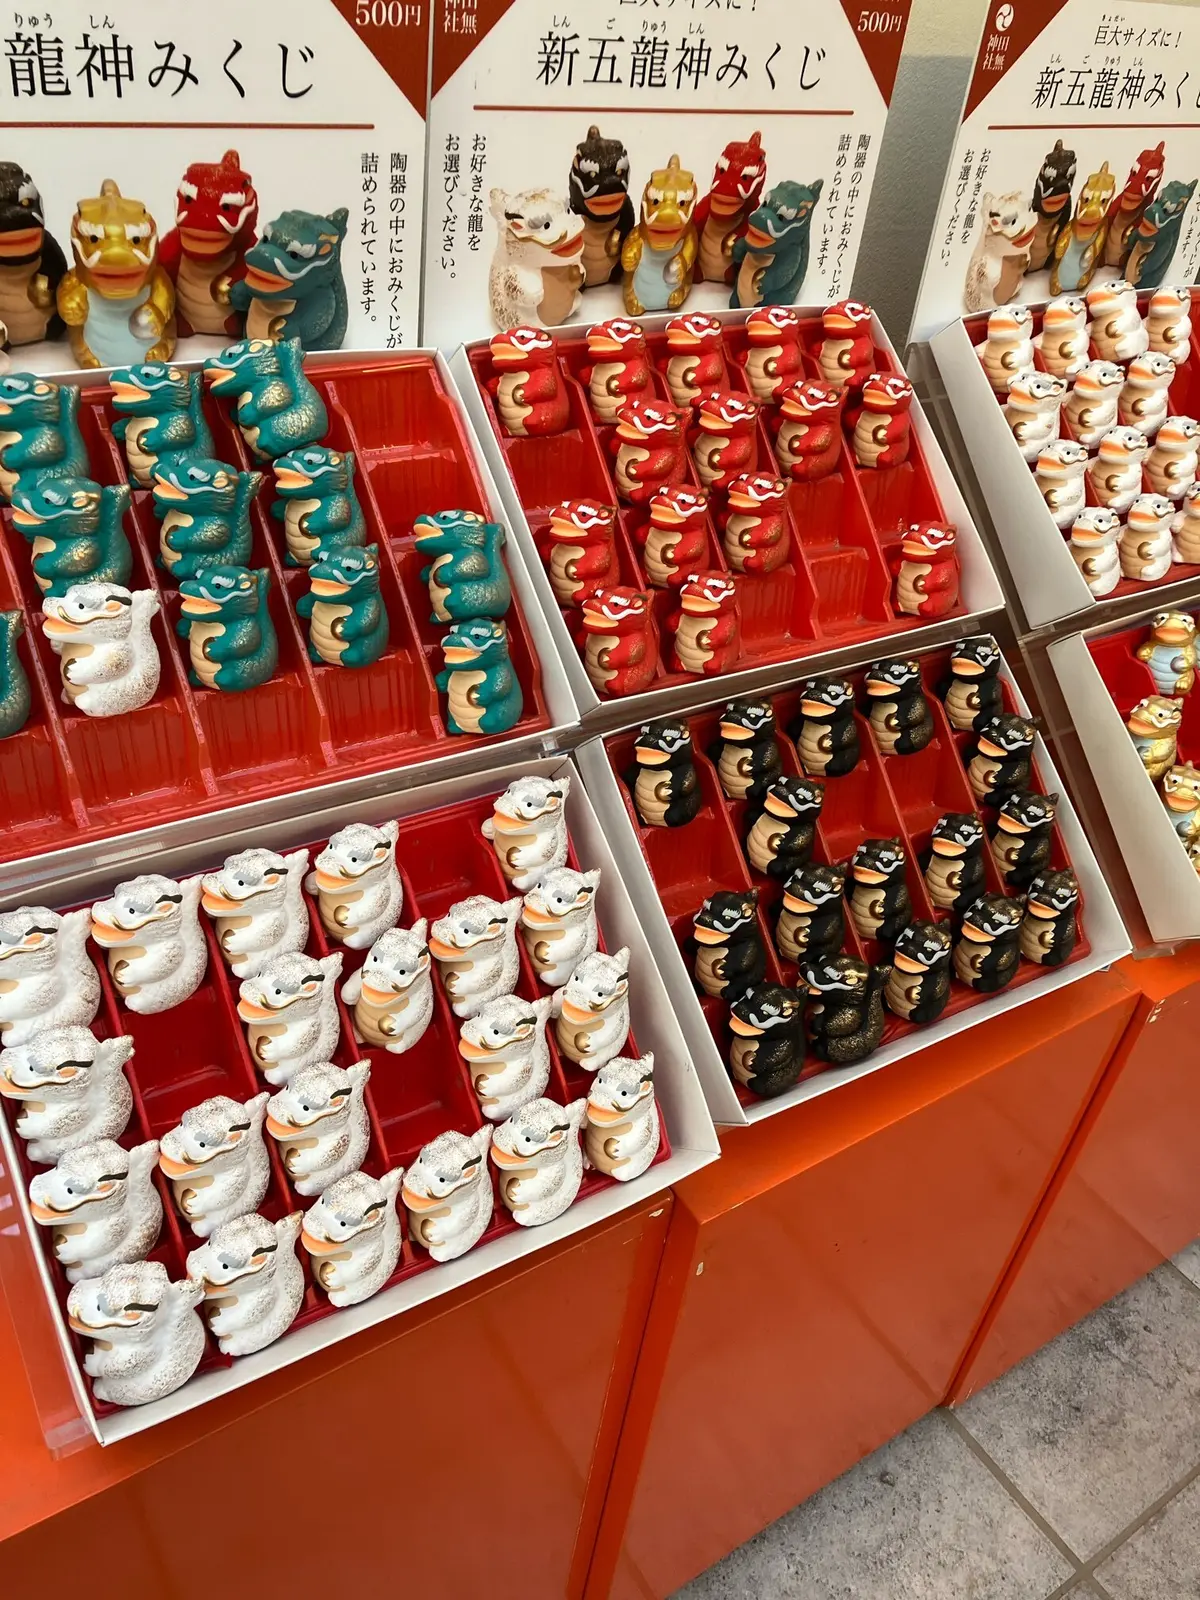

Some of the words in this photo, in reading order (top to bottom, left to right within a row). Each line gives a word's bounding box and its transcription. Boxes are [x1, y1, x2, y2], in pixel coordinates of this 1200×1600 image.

[14, 13, 54, 29] りゅう
[89, 15, 115, 29] しん
[355, 0, 421, 26] 500円
[536, 31, 826, 90] 新五龍神みくじ
[553, 15, 570, 28] しん
[642, 20, 667, 33] りゅう
[688, 22, 705, 35] しん
[857, 10, 902, 33] 500円
[4, 32, 315, 98] 龍神みくじ
[1031, 66, 1200, 109] 新五龍神みく
[360, 152, 379, 322] 詰められています。
[441, 133, 460, 279] お選びください。
[467, 133, 487, 251] お好きな龍を
[817, 134, 852, 275] 詰められています。
[827, 134, 871, 298] 陶器の中におみくじが
[941, 149, 974, 267] お選びください。
[961, 148, 991, 244] お好きな龍を
[386, 152, 408, 349] 陶器の中におみくじが
